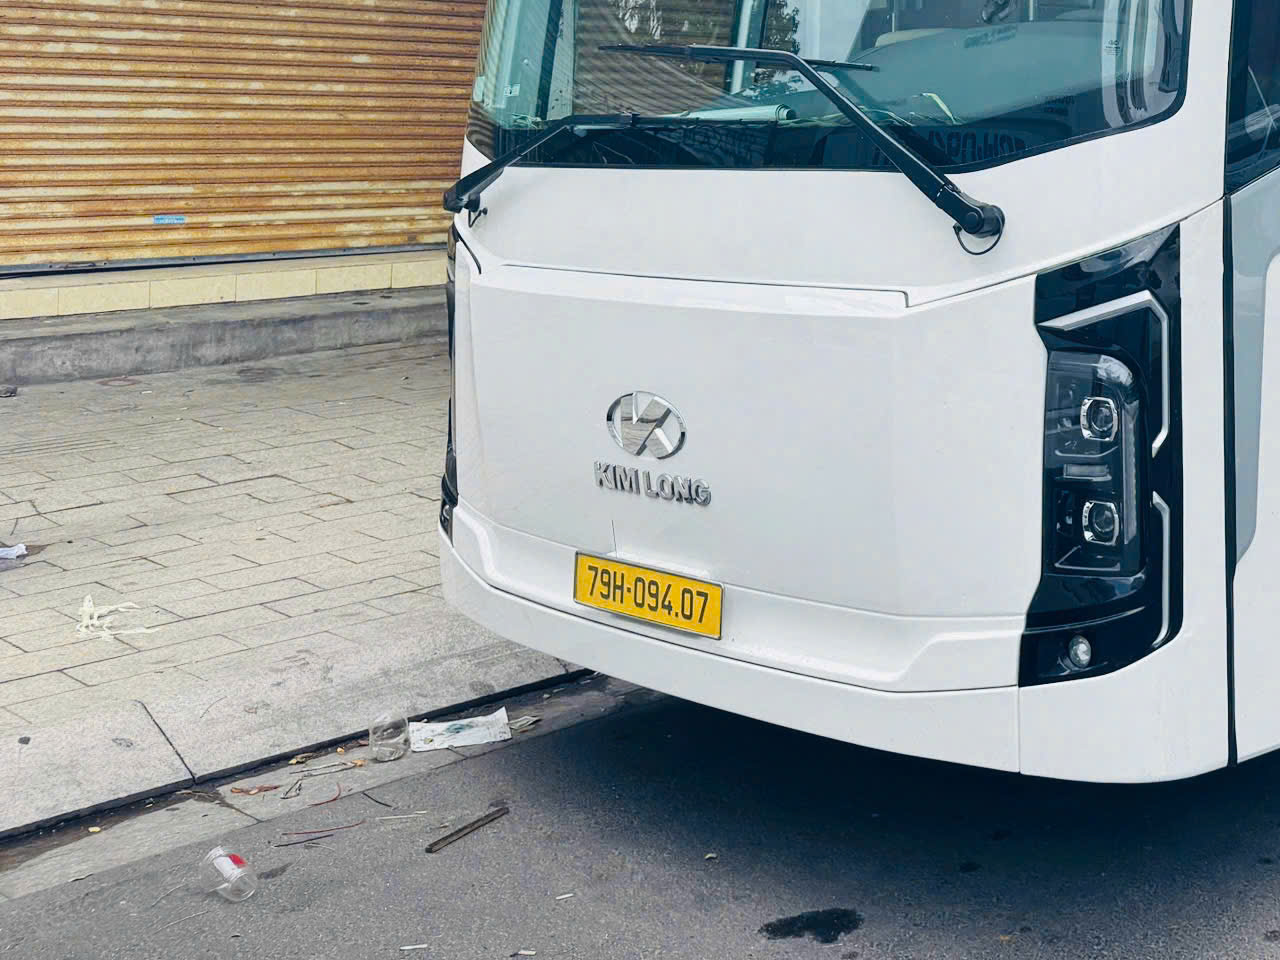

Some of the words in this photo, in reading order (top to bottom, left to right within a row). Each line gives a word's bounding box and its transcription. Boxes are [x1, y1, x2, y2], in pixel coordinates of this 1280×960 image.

[593, 460, 640, 496] KIM
[642, 469, 713, 507] LONG
[587, 564, 709, 625] 79H-094.07
